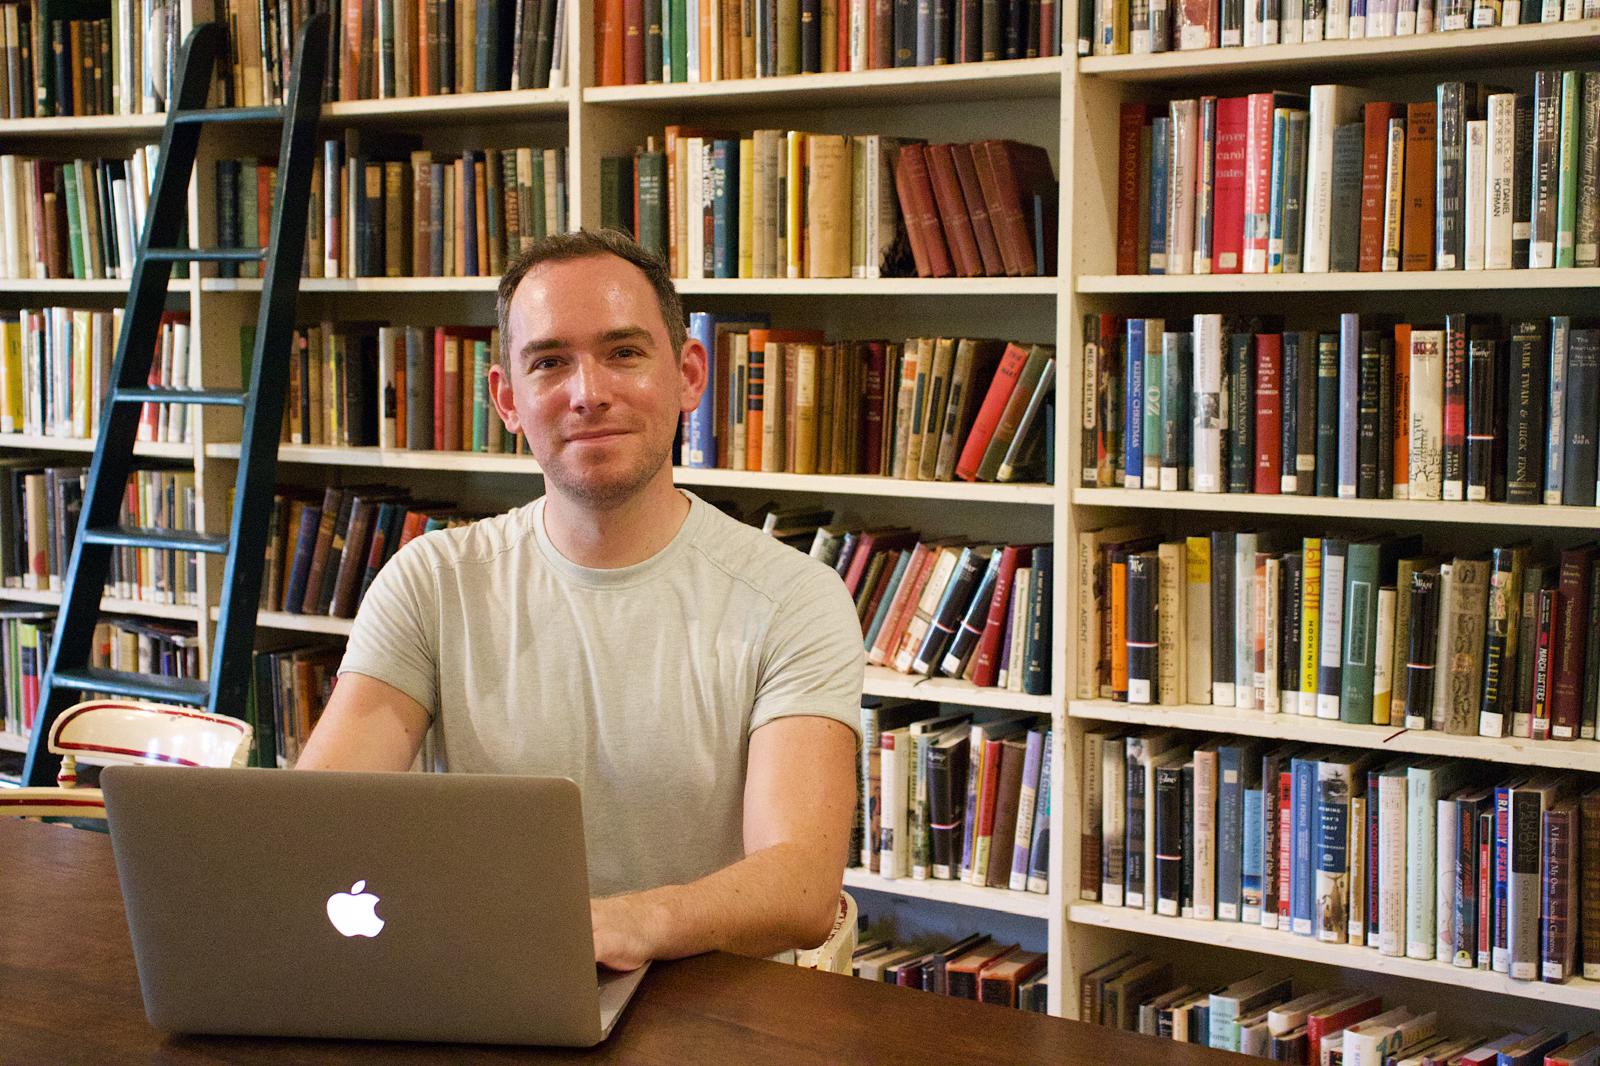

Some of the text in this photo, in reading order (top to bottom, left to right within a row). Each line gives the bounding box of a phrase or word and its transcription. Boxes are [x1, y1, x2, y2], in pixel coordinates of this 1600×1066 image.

[1495, 119, 1503, 135] POE
[1504, 119, 1512, 136] POE
[1537, 102, 1546, 138] POWELL
[1547, 106, 1555, 133] DAWN
[1216, 131, 1245, 146] joyce
[1495, 138, 1503, 155] POE
[1504, 139, 1512, 154] POE
[1125, 132, 1137, 199] NABOKOV
[1216, 147, 1245, 159] carol
[1258, 97, 1269, 210] Invisible Writer
[1503, 156, 1511, 173] POE
[1216, 168, 1243, 178] oates
[1503, 177, 1511, 187] BY
[1319, 171, 1329, 213] EINSTEIN
[1493, 178, 1501, 217] HOFFMAN
[1539, 162, 1548, 212] TIM PAGE
[1502, 188, 1510, 214] DANIEL
[1455, 331, 1464, 364] ZORA
[1521, 342, 1531, 368] MARK
[1147, 385, 1161, 416] OZ
[1237, 345, 1248, 447] The AMERICAN NOVEL
[1521, 372, 1530, 405] TWAIN
[1085, 406, 1093, 424] AMY
[1132, 360, 1142, 448] KEEPING CHRISTMAS
[1518, 422, 1528, 450] HUCK
[1516, 456, 1527, 483] FINN
[1080, 608, 1088, 642] AGENT
[1306, 674, 1313, 688] UP
[1486, 645, 1501, 703] FLAPPER
[1536, 647, 1548, 702] MARCH SISTERS
[1266, 792, 1276, 810] Jazz
[1266, 820, 1274, 833] the
[1496, 793, 1508, 882] BRADBURY SPEAKS
[1519, 800, 1528, 861] CAPOTE
[1527, 803, 1537, 864] TRUMAN
[1252, 819, 1261, 871] CONROY
[1266, 834, 1275, 853] Time
[1551, 833, 1560, 855] House
[1266, 862, 1274, 874] the
[1456, 859, 1463, 874] IN
[1549, 864, 1559, 877] My
[1265, 875, 1274, 895] Novel
[1550, 877, 1559, 895] Own
[1550, 900, 1559, 924] Sandra
[1456, 911, 1464, 949] WORLDS
[1521, 917, 1529, 956] PLIMPTON
[1549, 925, 1557, 953] Cisneros
